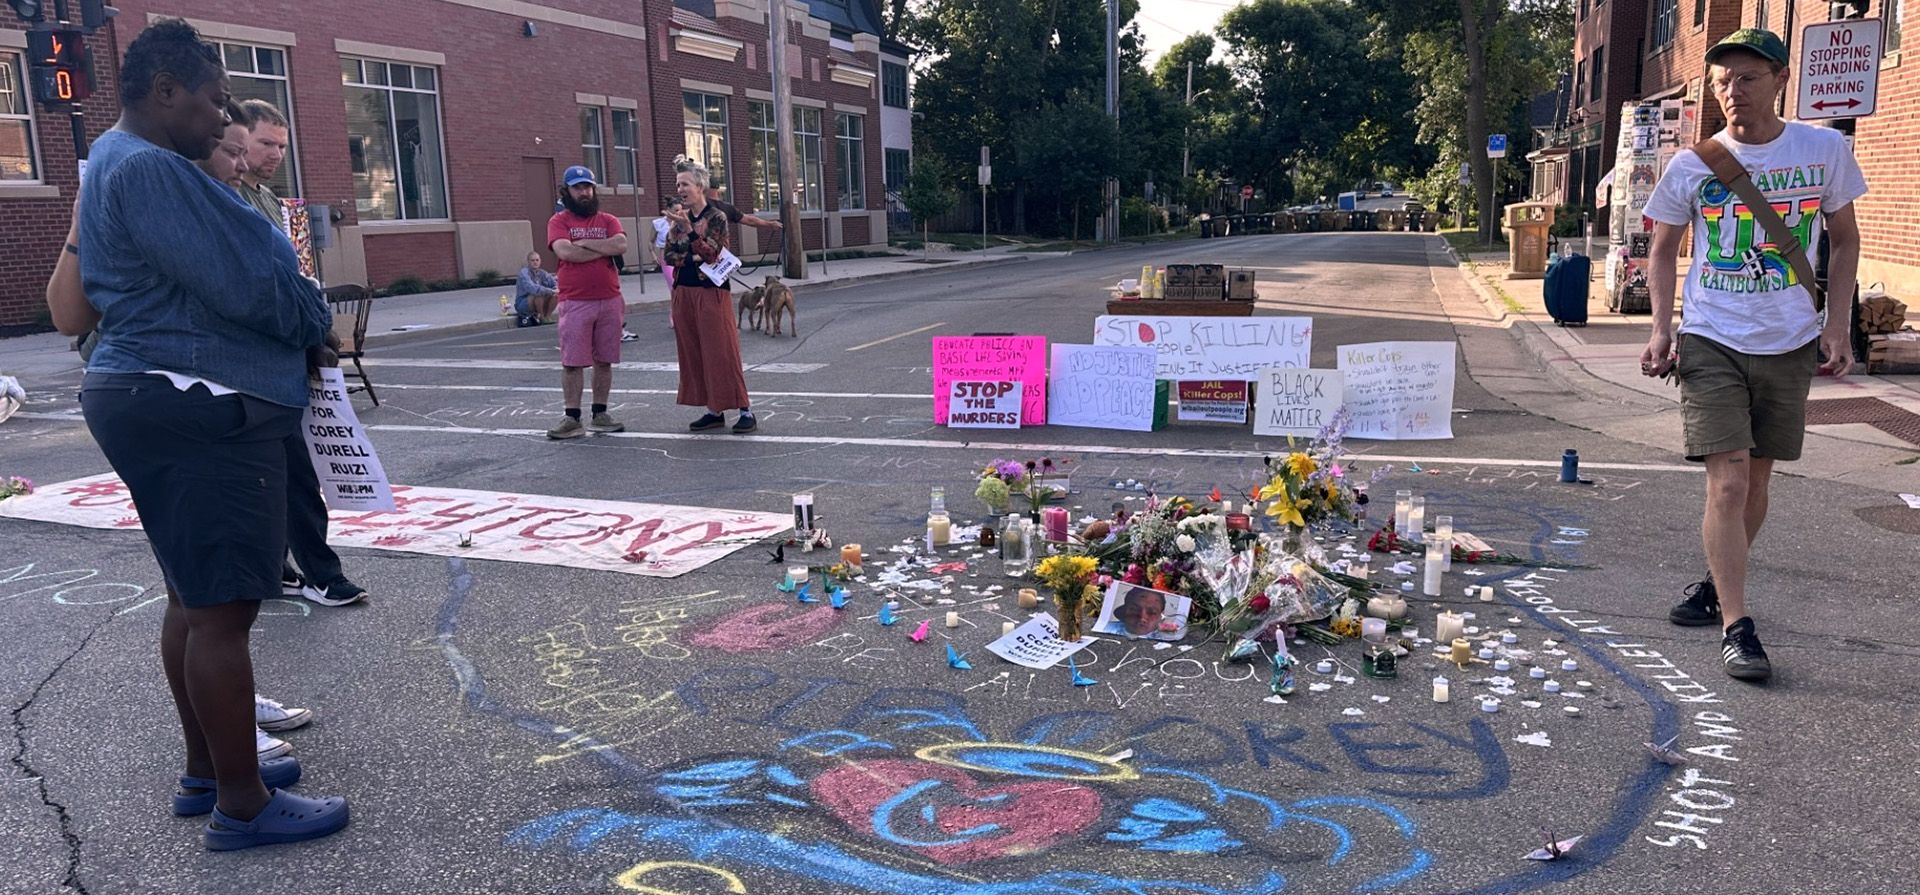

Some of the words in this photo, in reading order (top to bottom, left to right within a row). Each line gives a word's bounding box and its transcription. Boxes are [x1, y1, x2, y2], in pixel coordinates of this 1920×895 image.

[1830, 29, 1852, 46] NO
[1810, 45, 1871, 62] STOPPING
[1808, 59, 1870, 76] STANDING
[56, 71, 72, 100] 0
[1810, 80, 1864, 96] PARKING
[1748, 164, 1826, 192] AWAII
[1700, 268, 1781, 294] RAINBOWS
[1190, 320, 1304, 348] KILLING
[1068, 351, 1094, 372] NO
[1094, 351, 1156, 380] JUSTICE
[954, 381, 1014, 398] STOP
[1201, 382, 1224, 390] JAIL
[1272, 372, 1324, 398] BLACK
[964, 398, 996, 409] THE
[1054, 375, 1092, 416] NO
[1094, 378, 1152, 420] PEACE
[1183, 391, 1212, 399] Killer
[1213, 391, 1242, 400] Cops!
[1277, 396, 1310, 406] LIVES
[312, 406, 336, 419] FOR
[951, 412, 1018, 424] MURDERS
[1270, 408, 1322, 426] MATTER
[309, 424, 354, 438] COREY
[314, 443, 370, 458] DURELL
[329, 462, 370, 476] RUIZ!
[1503, 572, 1579, 614] POINT
[1559, 616, 1623, 635] AT
[1016, 636, 1060, 656] DURELL
[1026, 634, 1068, 652] COREY
[1042, 636, 1066, 646] FOR
[1686, 711, 1742, 762] AND
[1645, 768, 1734, 850] SHOT
